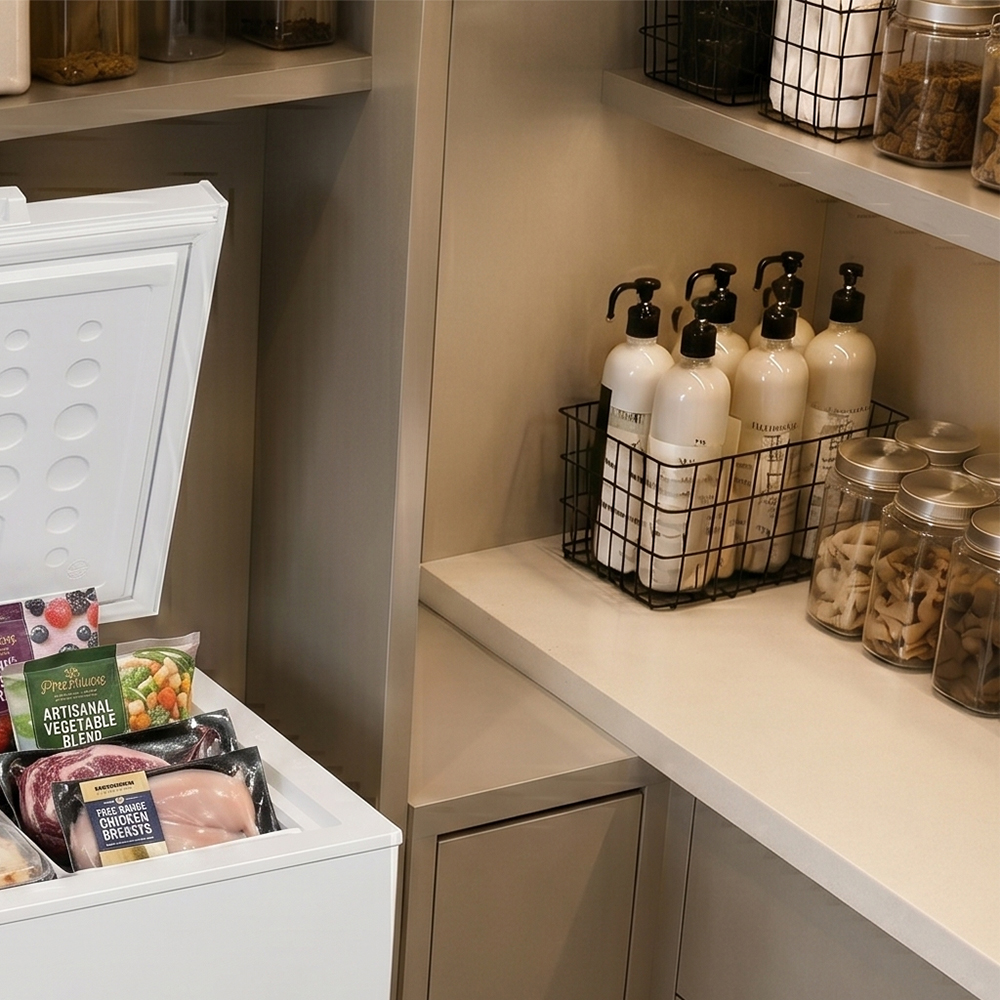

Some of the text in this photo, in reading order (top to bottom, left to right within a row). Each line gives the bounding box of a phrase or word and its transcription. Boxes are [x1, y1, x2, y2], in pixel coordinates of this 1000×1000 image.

[43, 699, 113, 722] ARTISANAL
[43, 713, 117, 736] VEGETABLE
[62, 730, 102, 748] BLEND
[102, 823, 152, 841] BREASTS
